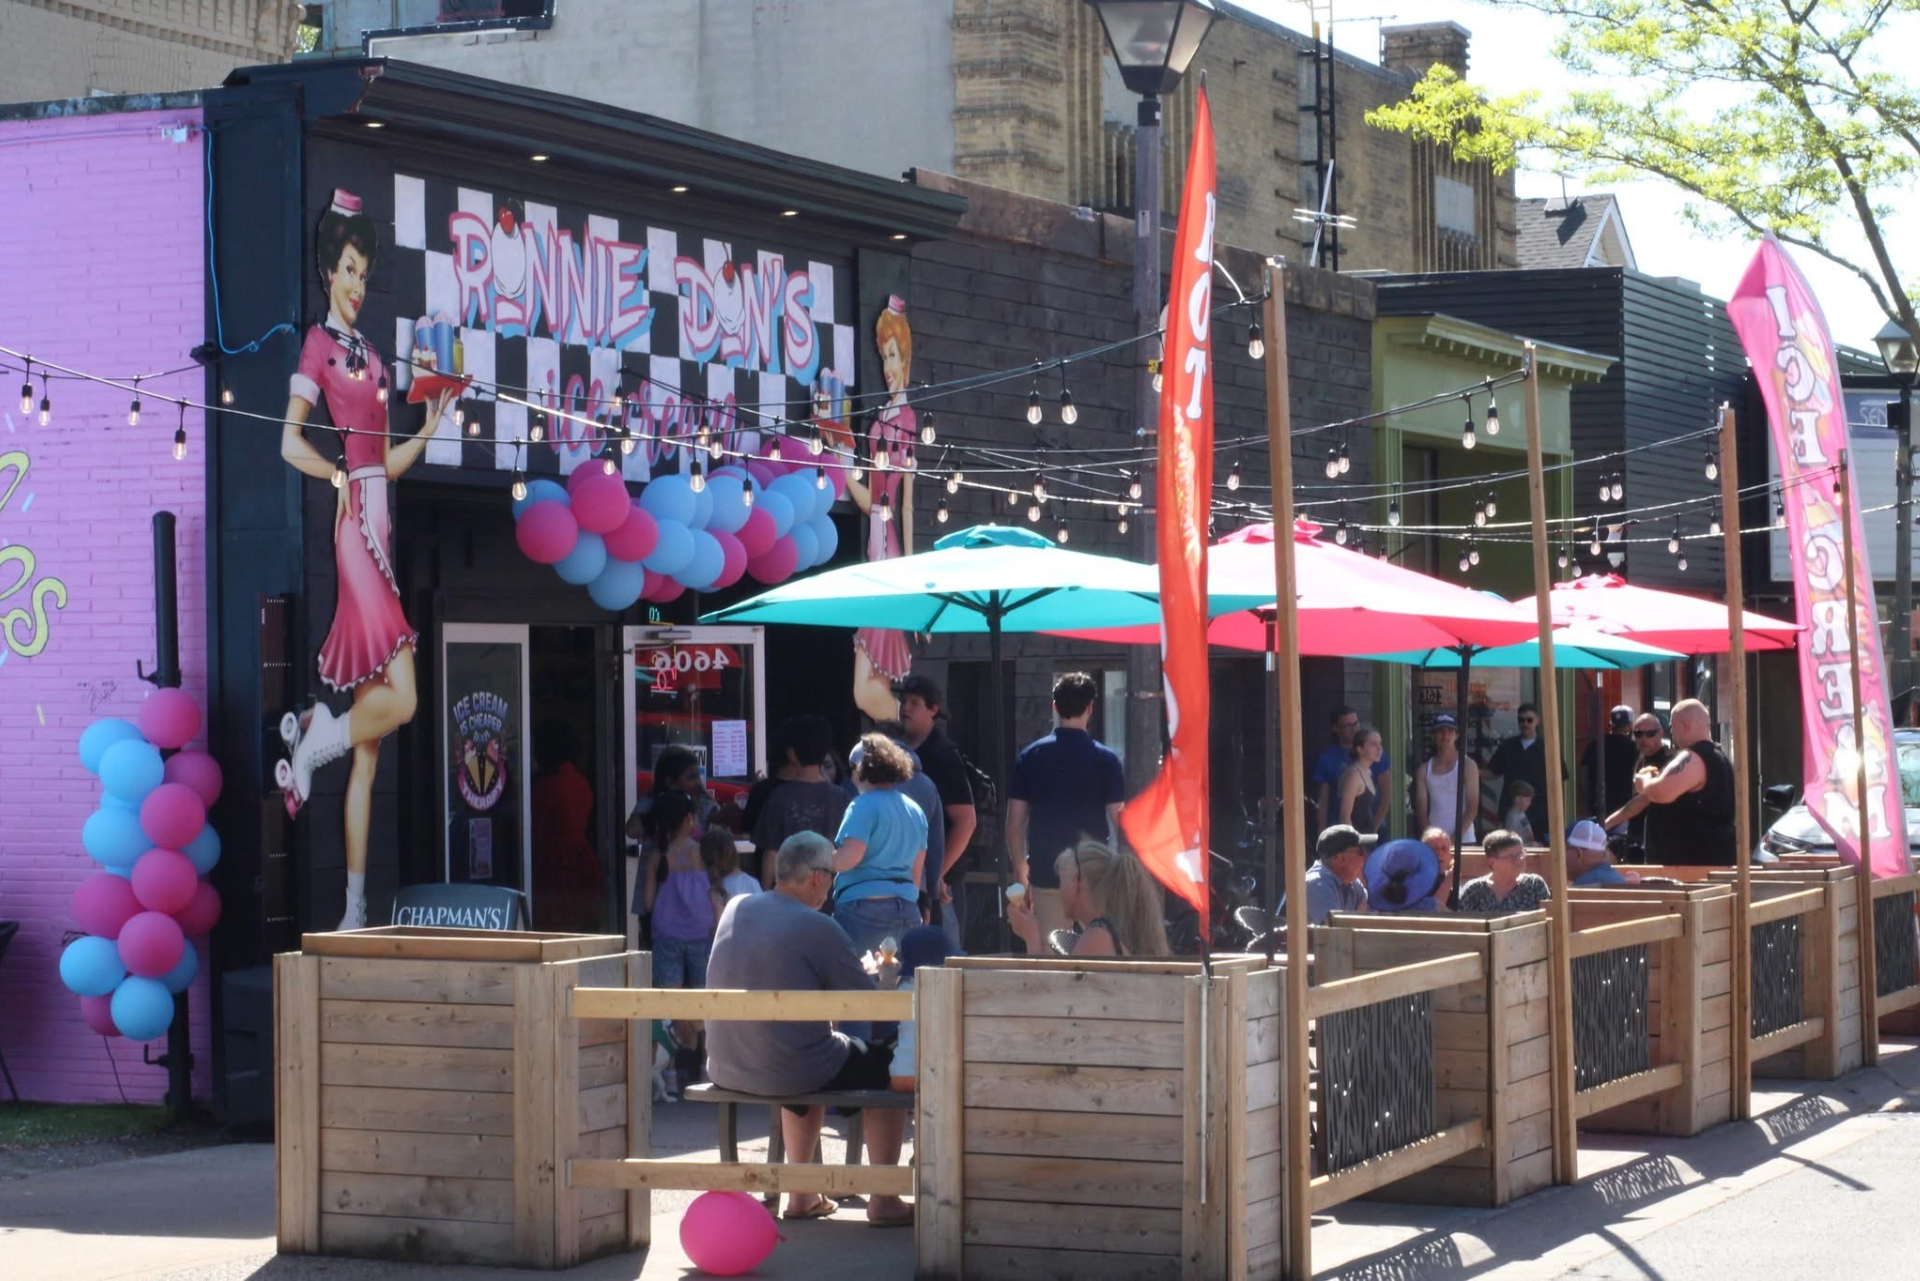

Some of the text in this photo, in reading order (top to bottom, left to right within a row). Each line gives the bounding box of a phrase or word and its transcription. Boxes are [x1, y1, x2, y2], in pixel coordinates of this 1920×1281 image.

[448, 201, 818, 380] RONNIE DON'S
[453, 691, 509, 723] ICE CREAM
[460, 712, 502, 737] IS CHEAPER
[462, 776, 504, 810] THERAPY
[397, 905, 501, 931] CHAPMAN'S
